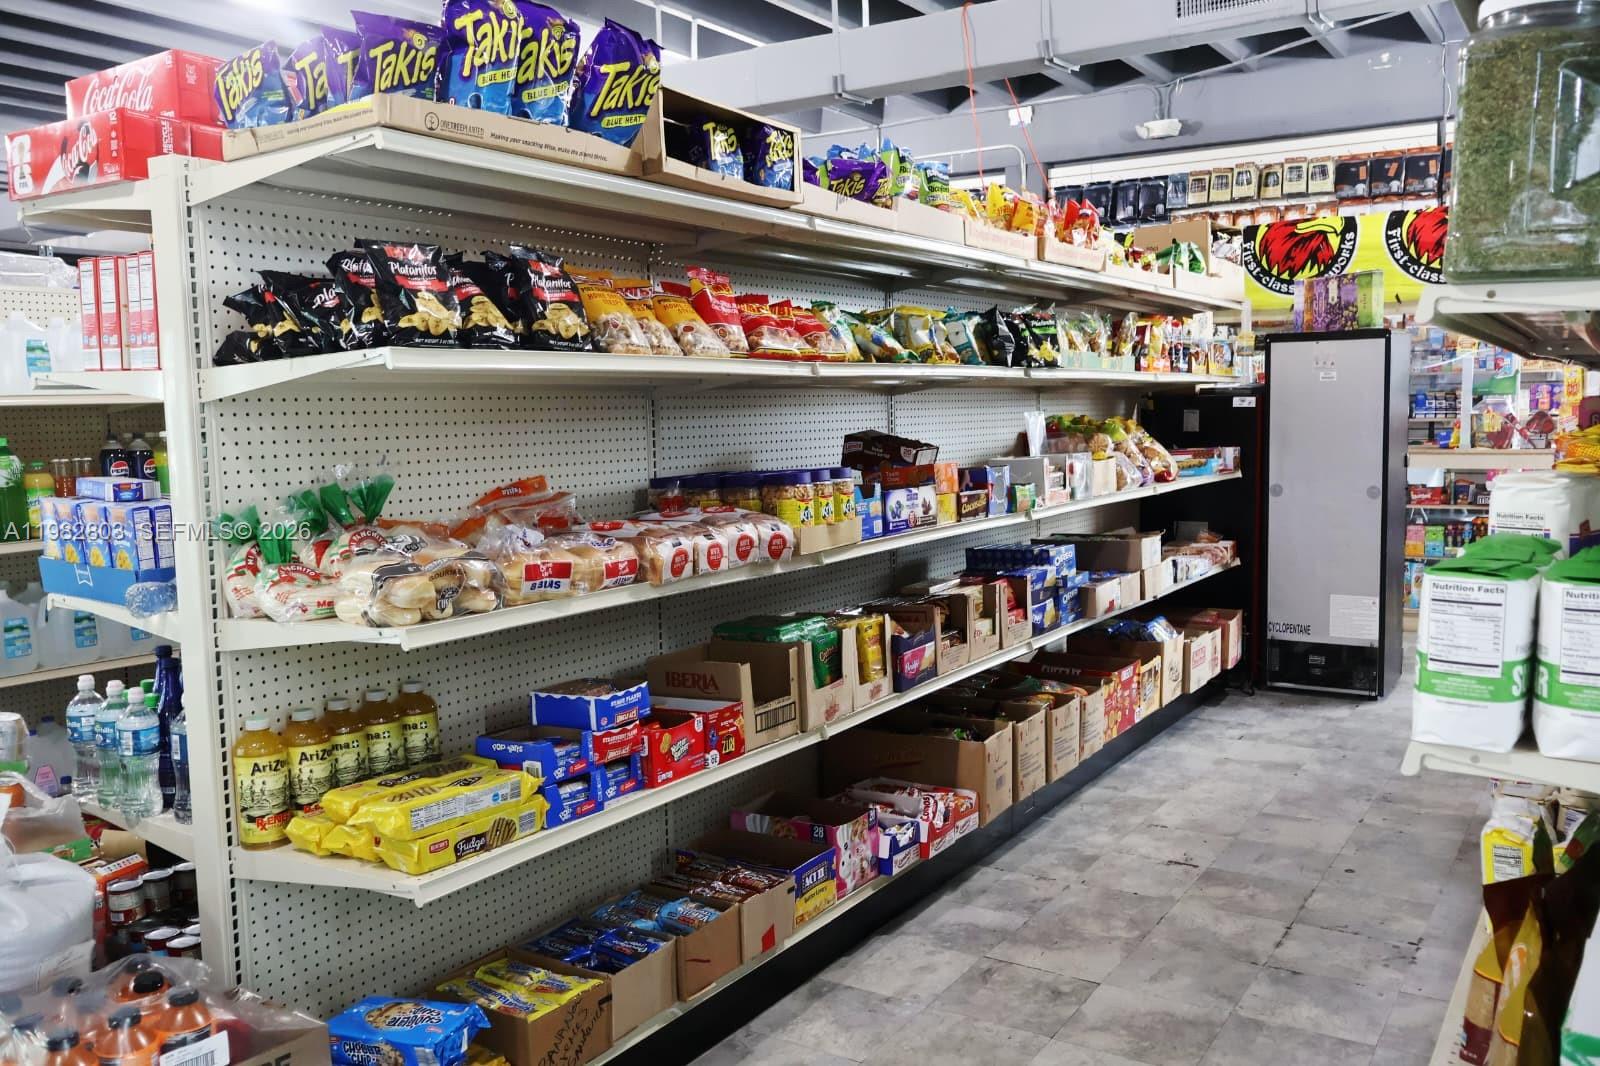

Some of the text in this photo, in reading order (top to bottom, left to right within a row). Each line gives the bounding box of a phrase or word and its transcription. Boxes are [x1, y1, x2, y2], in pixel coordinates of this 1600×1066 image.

[370, 41, 438, 94] Takis
[215, 49, 264, 121] Takis
[481, 73, 498, 83] BLUE
[527, 89, 546, 101] BLUE
[591, 62, 660, 117] Takis
[606, 115, 642, 126] BLUE HEAT
[830, 174, 866, 200] Takis
[387, 260, 438, 276] Platanitos
[1496, 512, 1545, 522] Nutrition Facts
[1055, 550, 1074, 565] OREO
[1431, 582, 1505, 595] Nutrition Facts
[1268, 621, 1311, 636] CYCLOPENTANE
[665, 671, 721, 695] IBERIA
[813, 825, 824, 838] 28
[457, 835, 487, 856] Fudge
[343, 1040, 382, 1056] CHOCOLATE
